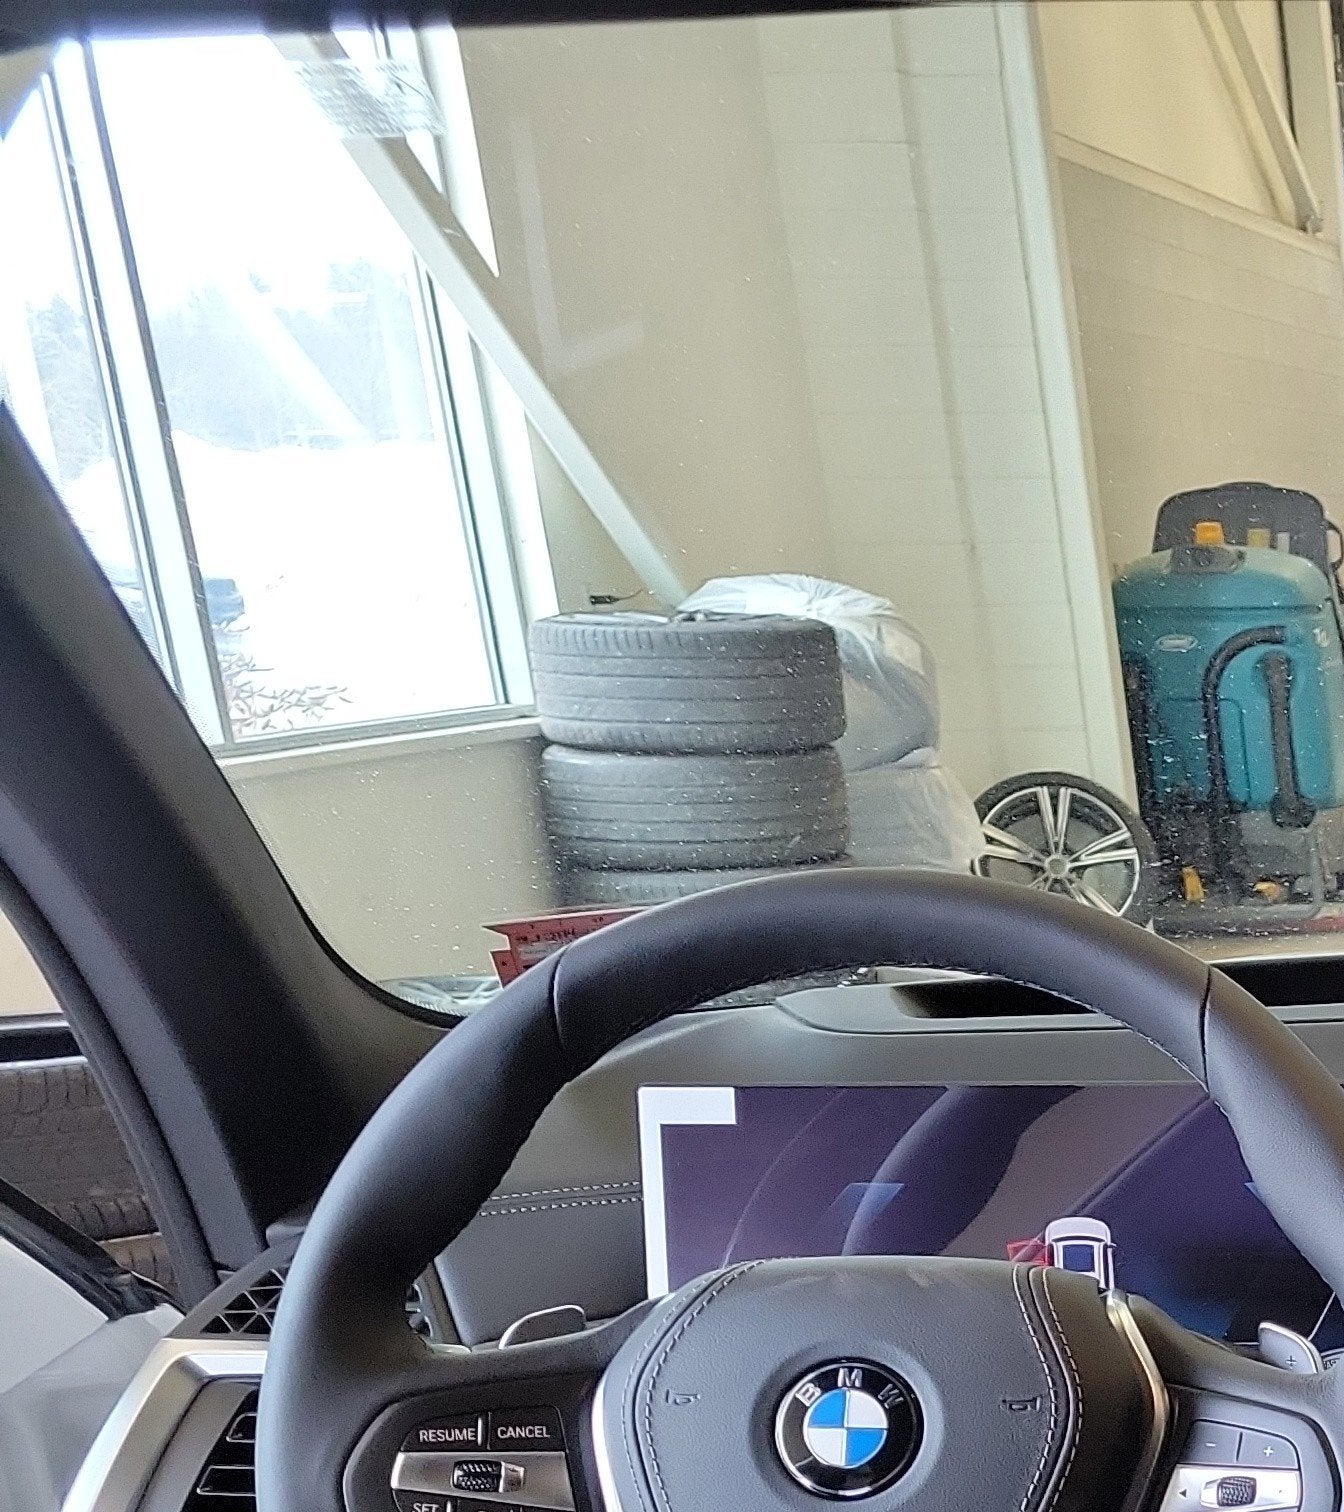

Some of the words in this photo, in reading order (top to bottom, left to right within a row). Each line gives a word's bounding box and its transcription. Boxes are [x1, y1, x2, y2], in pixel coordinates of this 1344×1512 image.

[794, 1367, 904, 1409] BMW
[419, 1428, 477, 1443] RESUME
[497, 1425, 551, 1439] CANCEL
